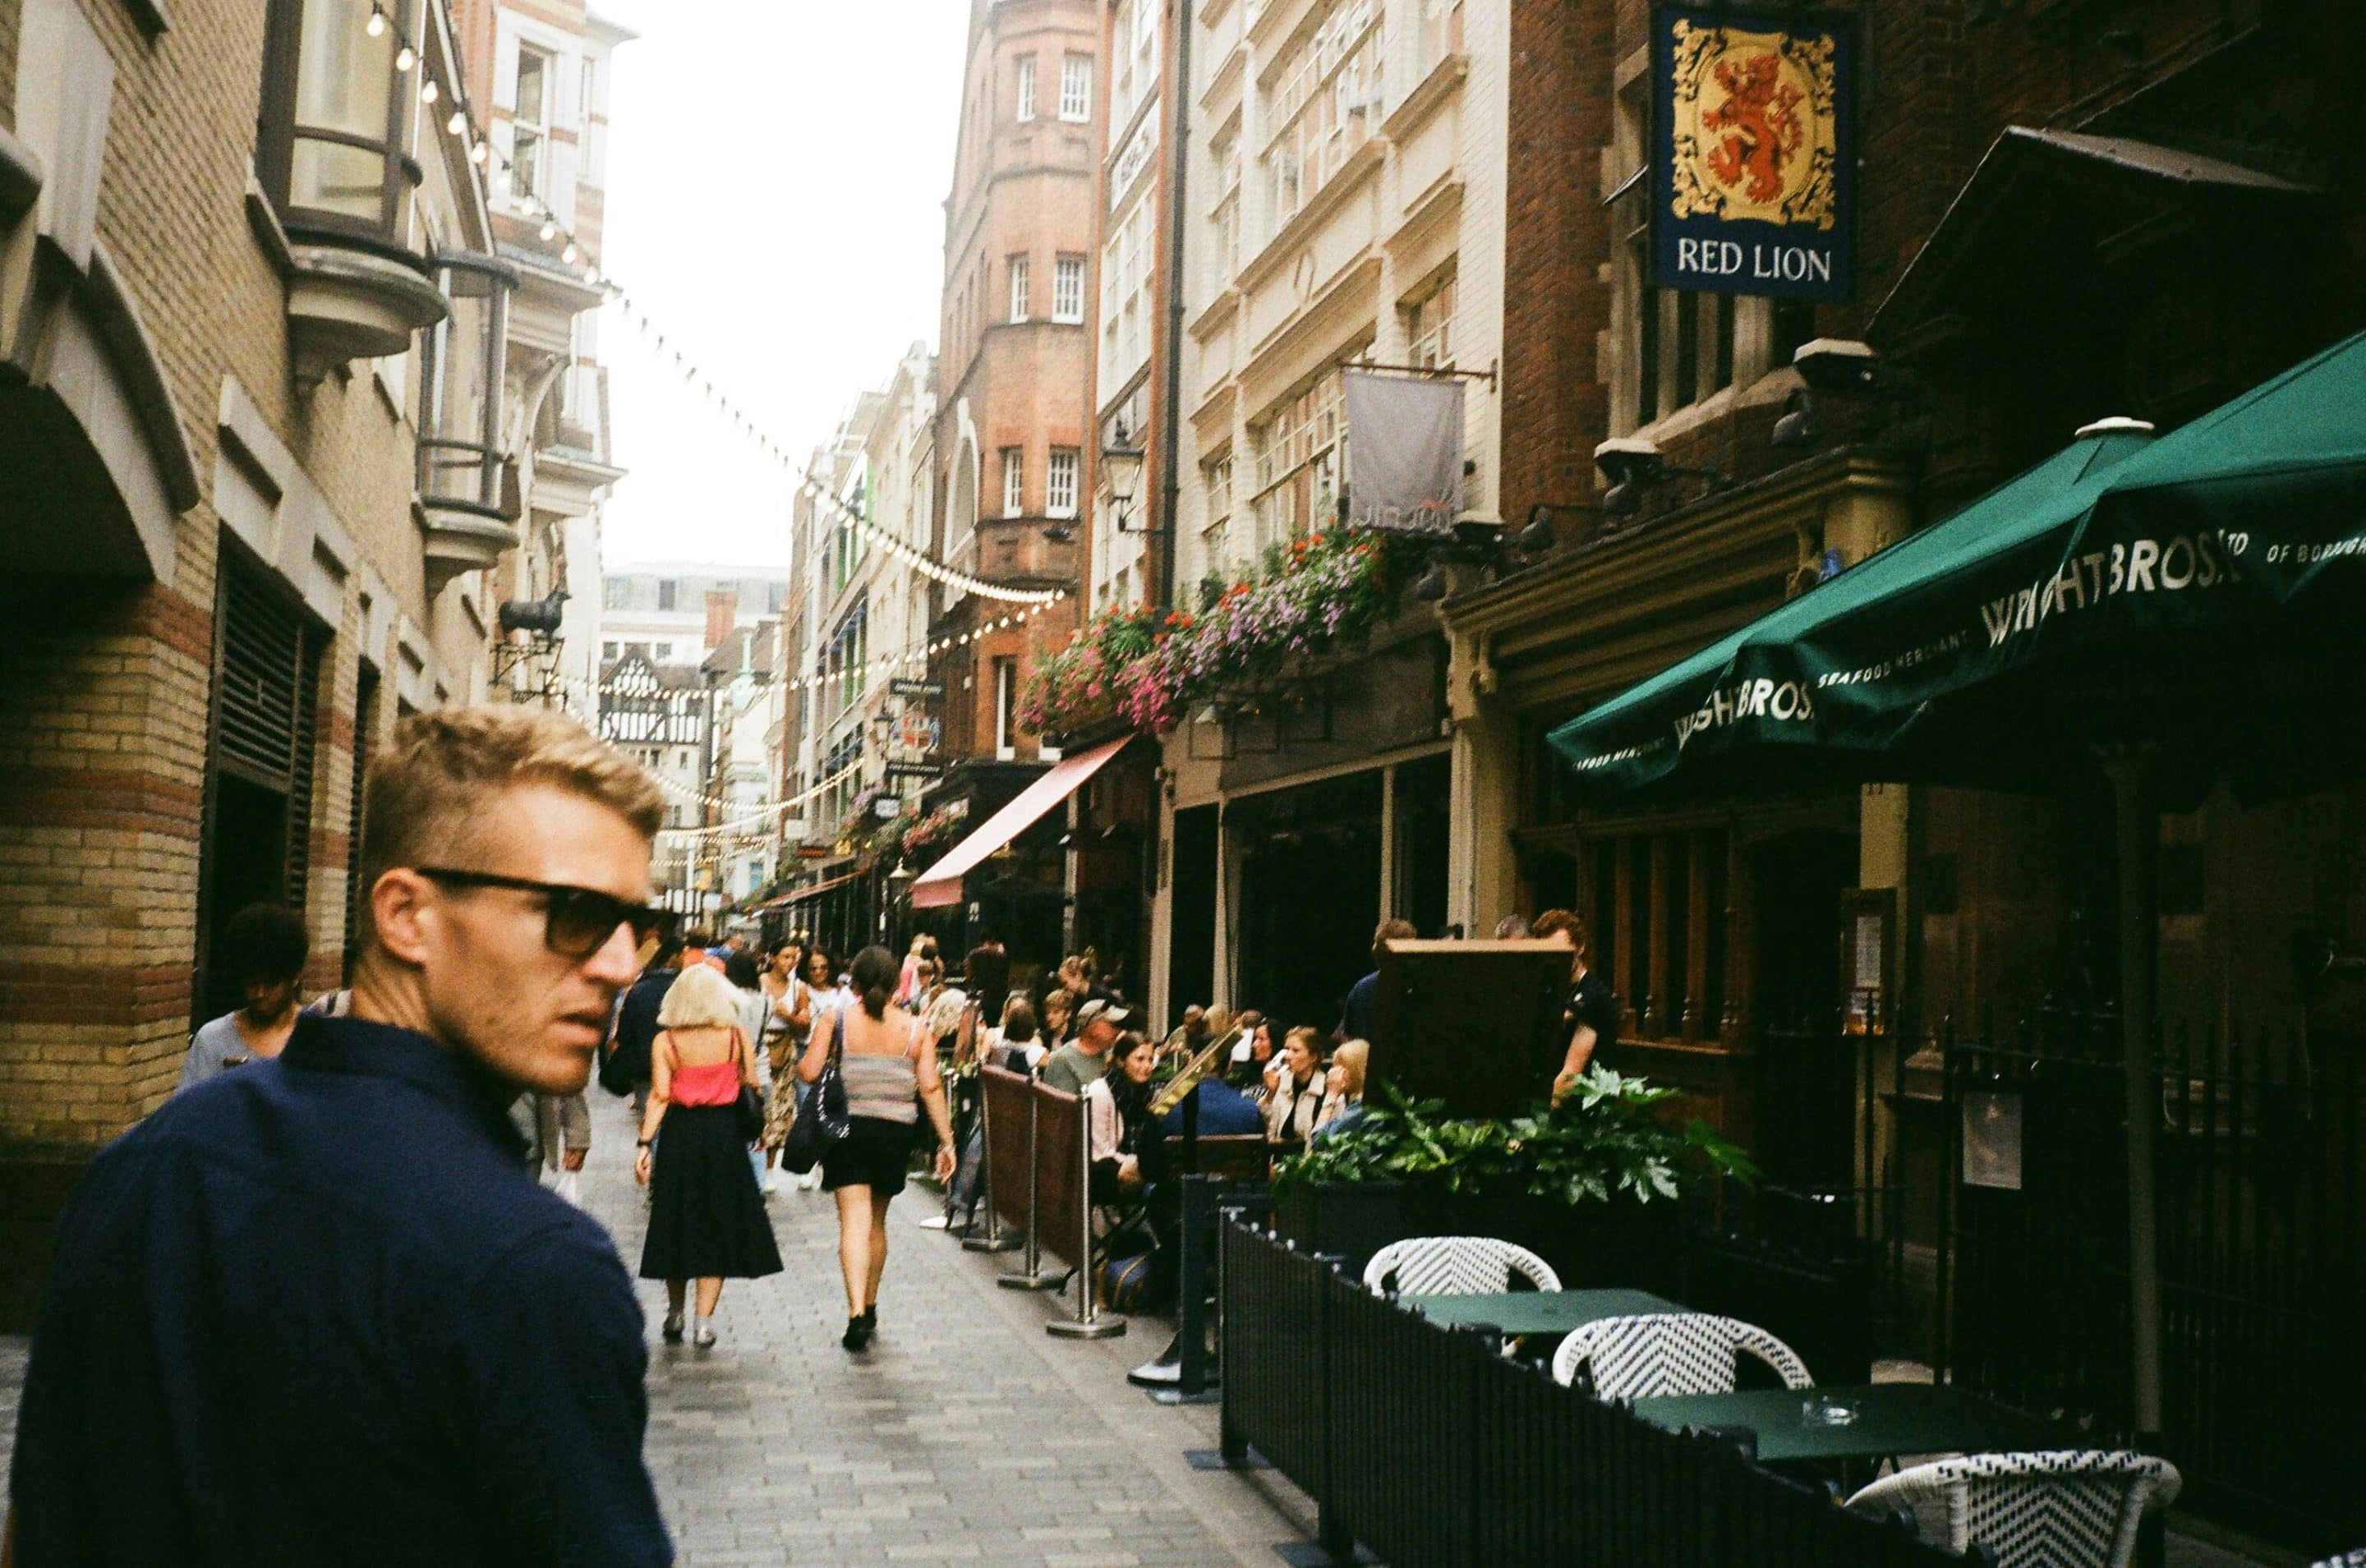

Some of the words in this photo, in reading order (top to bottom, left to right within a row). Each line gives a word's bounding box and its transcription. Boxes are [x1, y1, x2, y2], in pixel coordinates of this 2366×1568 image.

[1678, 237, 1743, 274] RED
[1753, 244, 1831, 283] LION
[1817, 660, 1891, 689] SEAFOOD
[2267, 543, 2291, 564] OF
